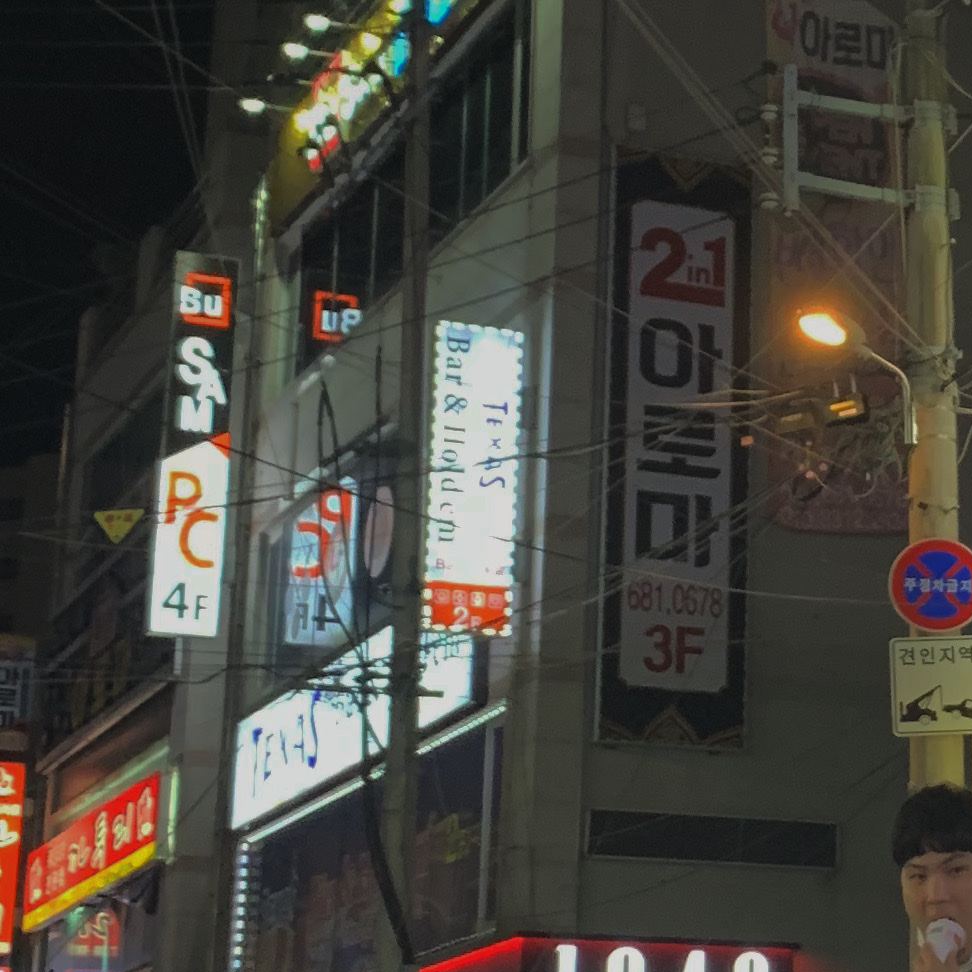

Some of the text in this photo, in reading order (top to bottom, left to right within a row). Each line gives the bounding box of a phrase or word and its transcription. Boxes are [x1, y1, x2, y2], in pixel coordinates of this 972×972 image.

[445, 336, 471, 386] Bar
[444, 393, 468, 415] &
[163, 471, 218, 568] PC
[161, 582, 209, 621] 4F
[903, 576, 972, 594] 주정차금지
[642, 624, 706, 674] 3F
